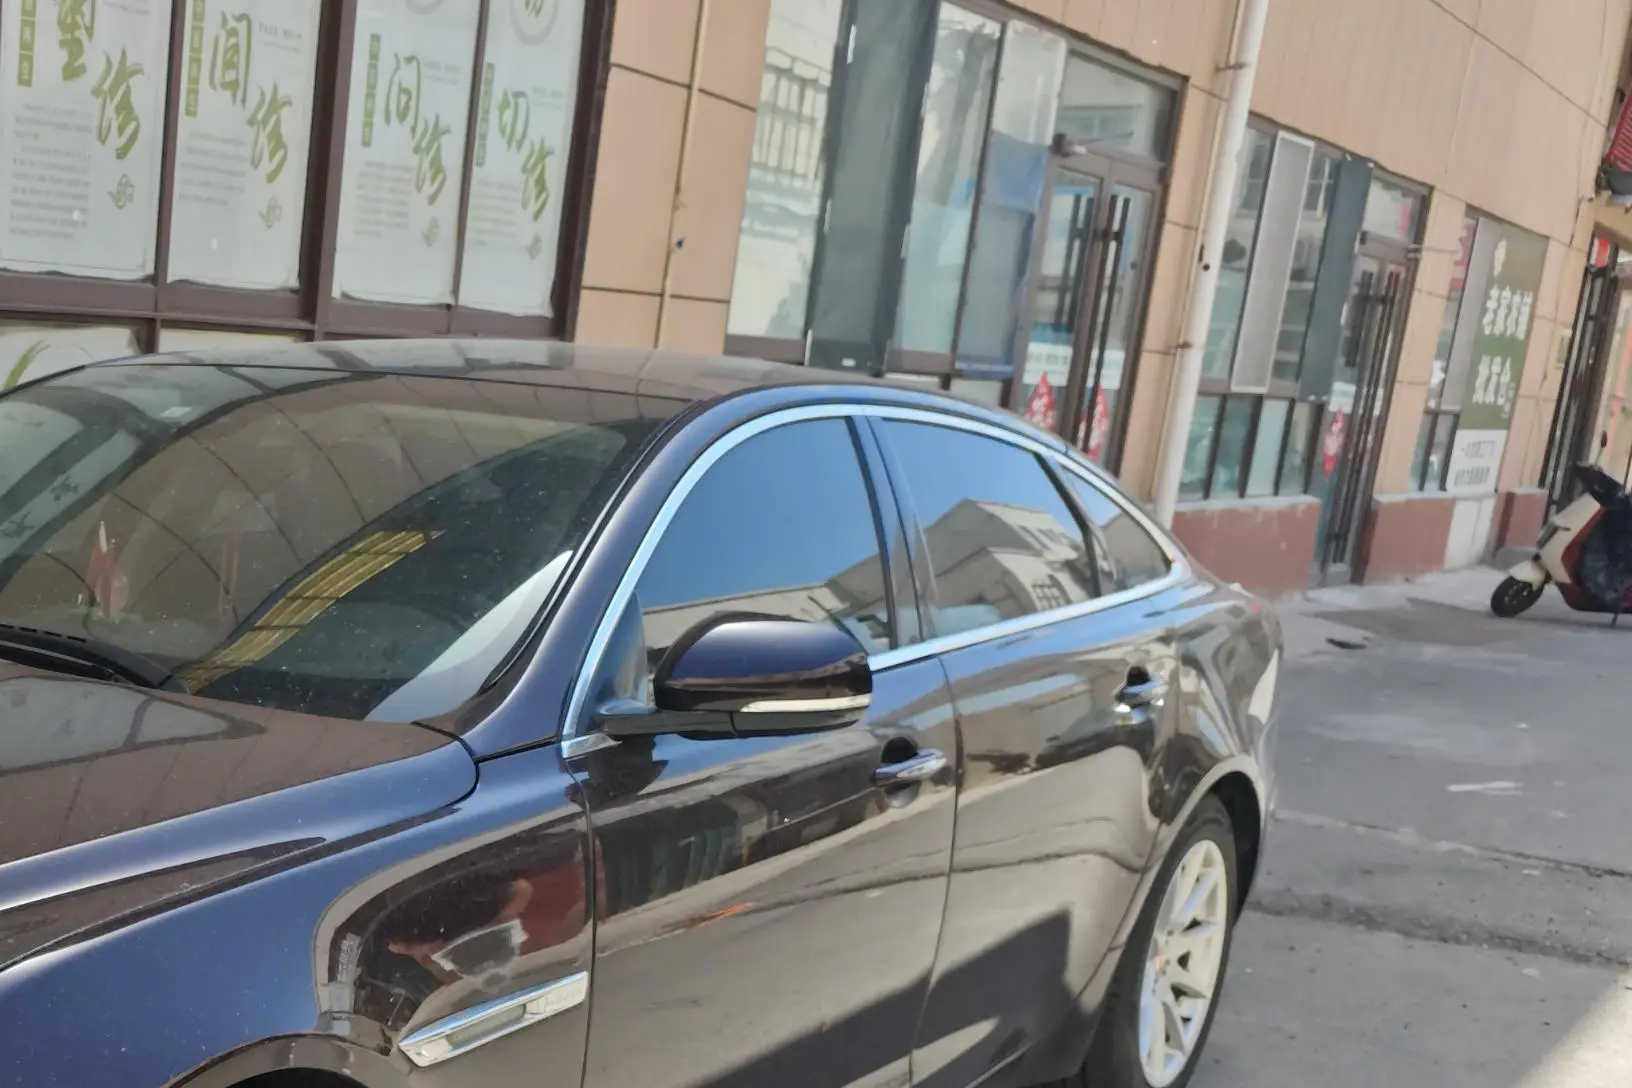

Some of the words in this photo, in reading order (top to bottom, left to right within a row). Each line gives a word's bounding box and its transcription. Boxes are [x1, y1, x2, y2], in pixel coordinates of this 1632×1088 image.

[209, 9, 293, 184] 闻诊
[384, 52, 452, 206] 问诊
[497, 87, 555, 222] 切诊
